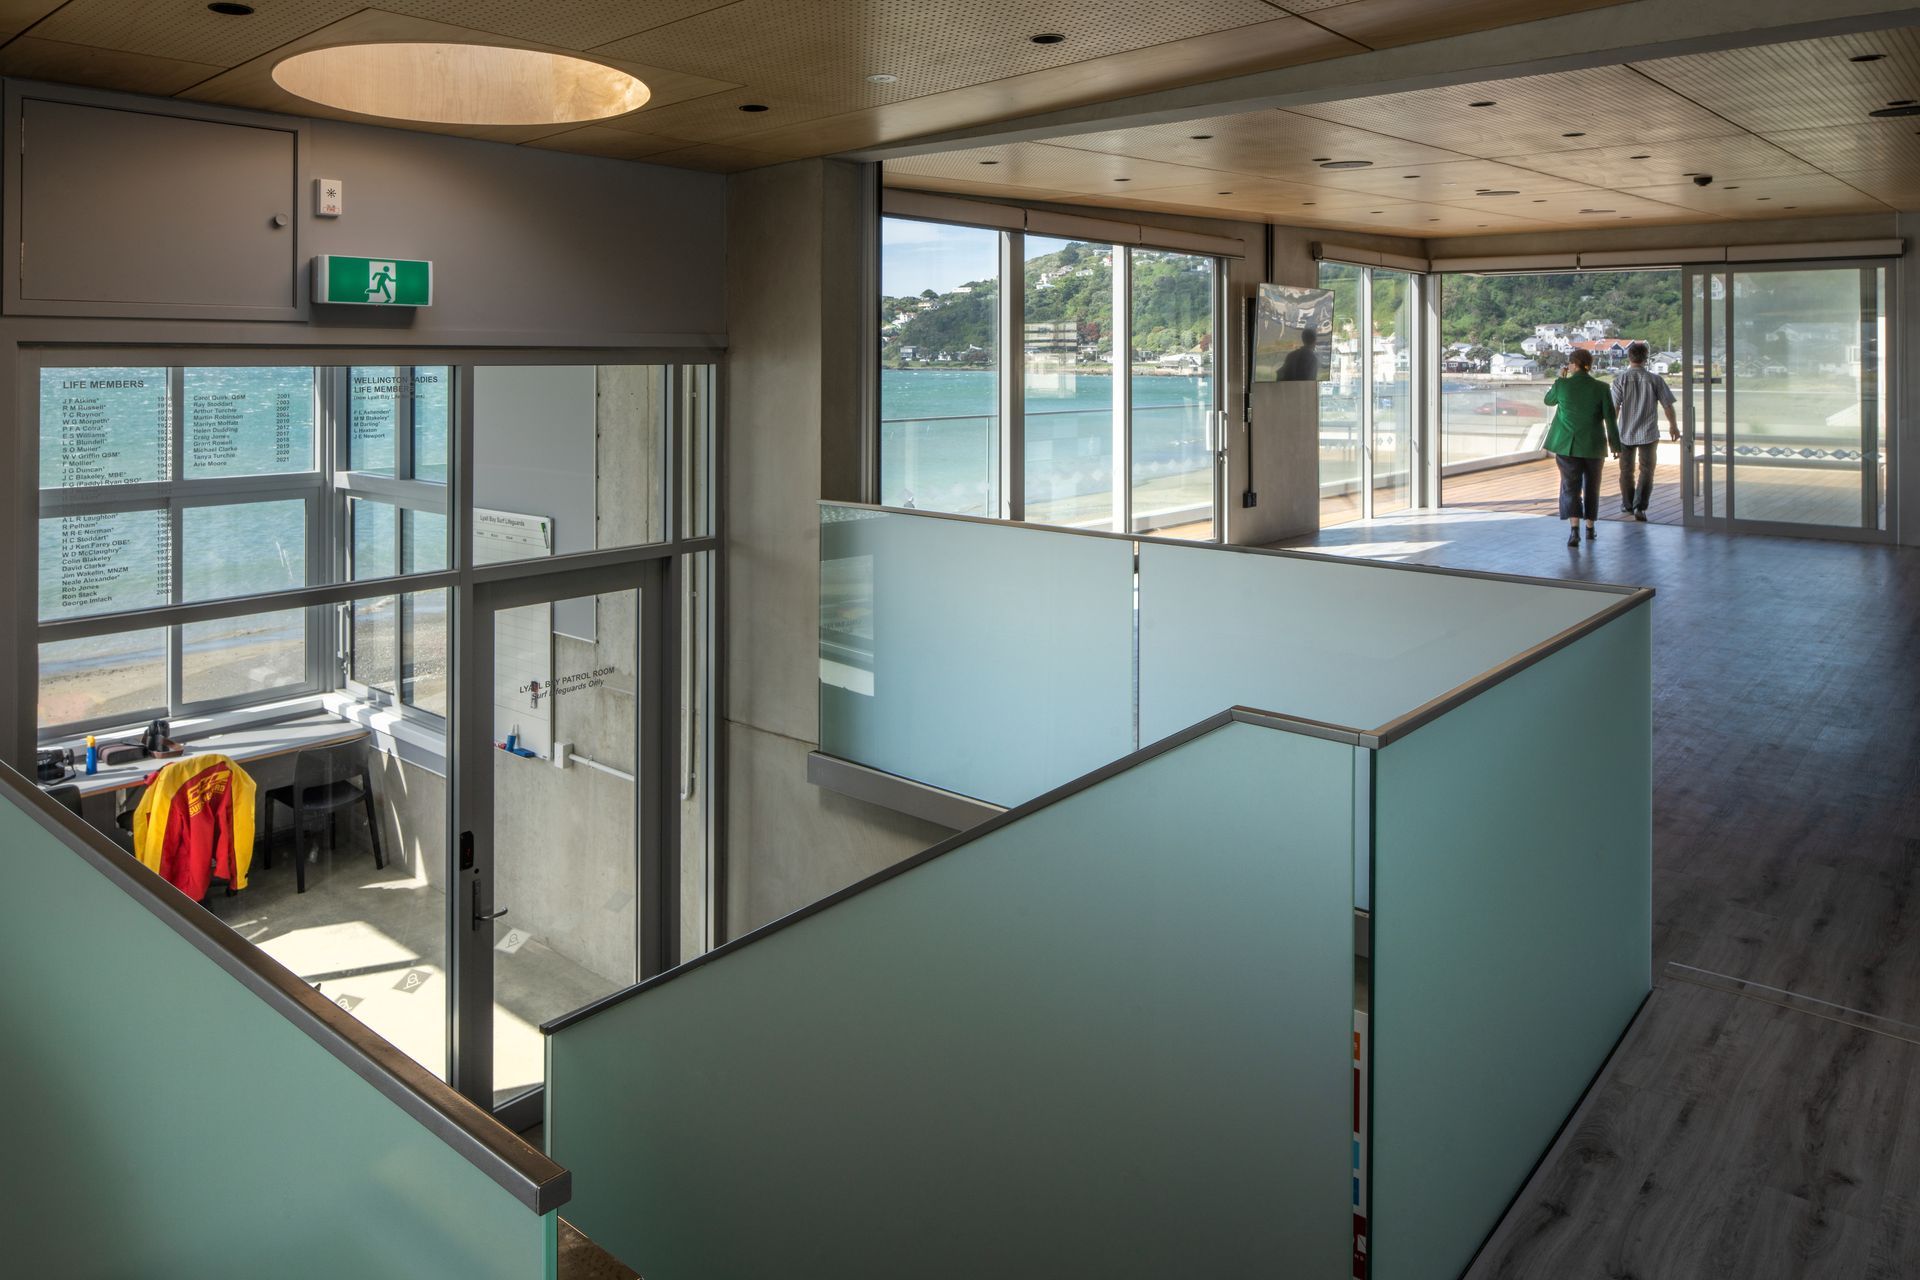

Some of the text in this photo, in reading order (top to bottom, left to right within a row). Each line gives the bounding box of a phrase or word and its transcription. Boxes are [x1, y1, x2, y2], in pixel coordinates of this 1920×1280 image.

[63, 380, 144, 389] LIFE MEMBERS
[354, 376, 408, 384] WELLINGTON
[545, 679, 560, 688] BY
[562, 672, 591, 684] PATROL
[592, 667, 615, 678] ROOM
